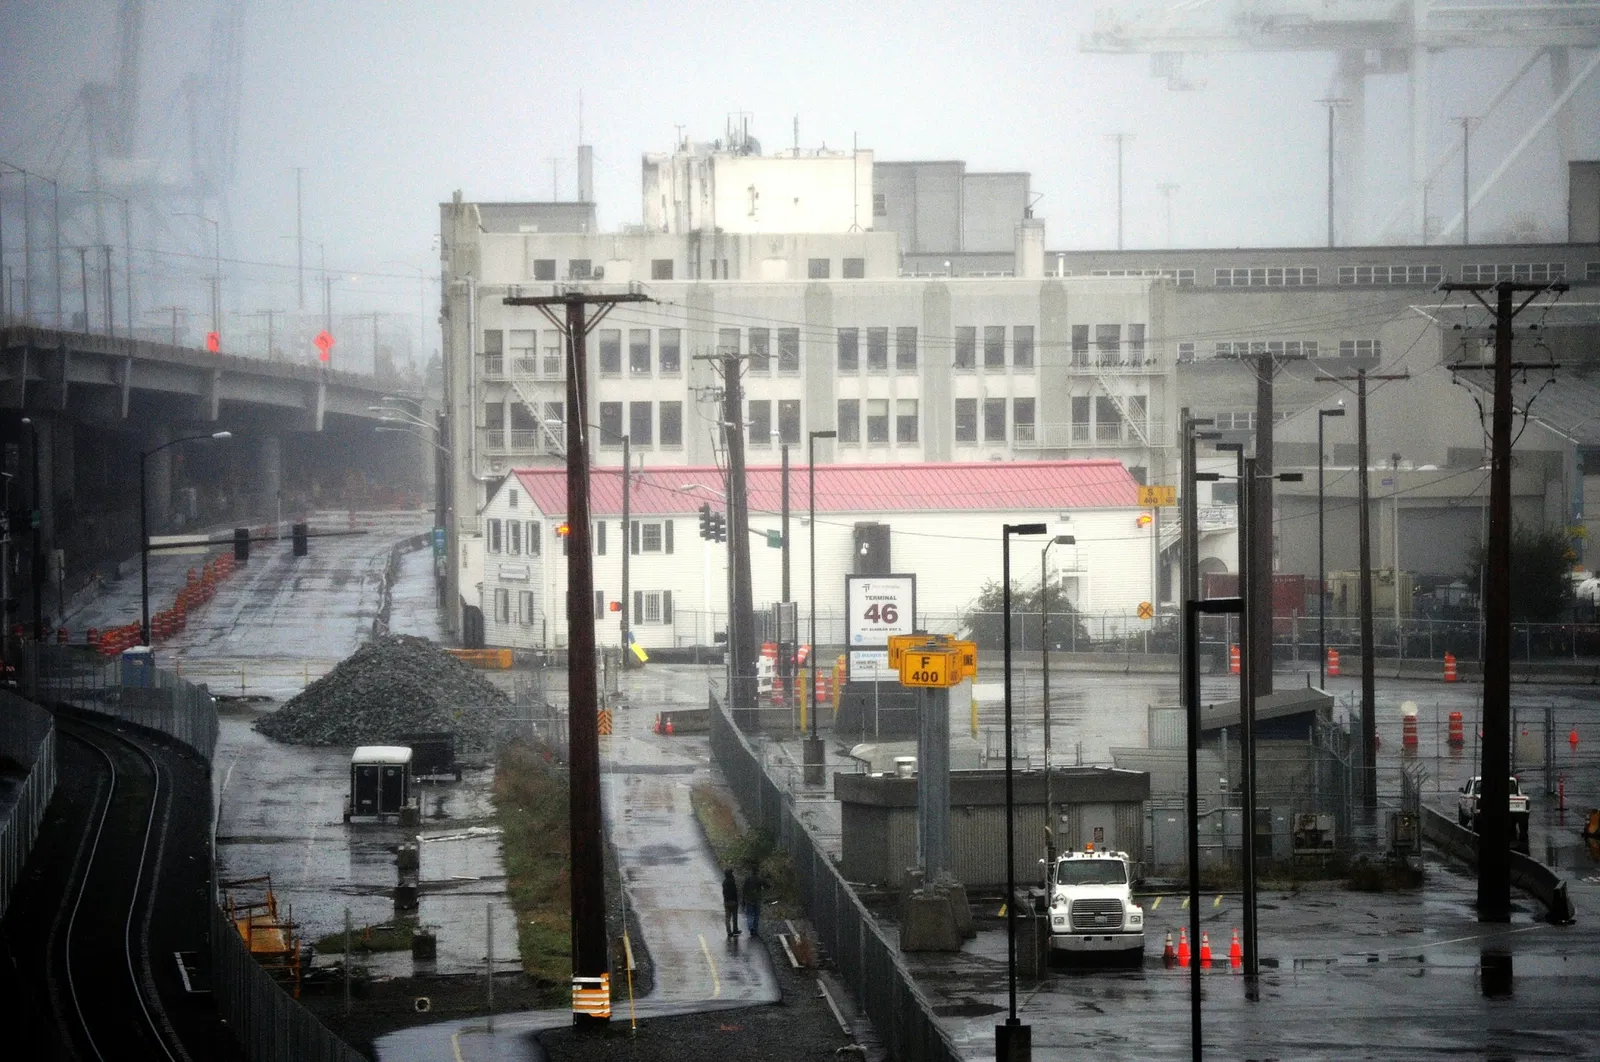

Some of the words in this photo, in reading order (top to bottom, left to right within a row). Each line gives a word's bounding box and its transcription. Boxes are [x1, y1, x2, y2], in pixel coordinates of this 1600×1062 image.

[1147, 488, 1154, 496] S
[863, 603, 899, 624] 46
[921, 656, 931, 669] F
[912, 671, 939, 682] 400
